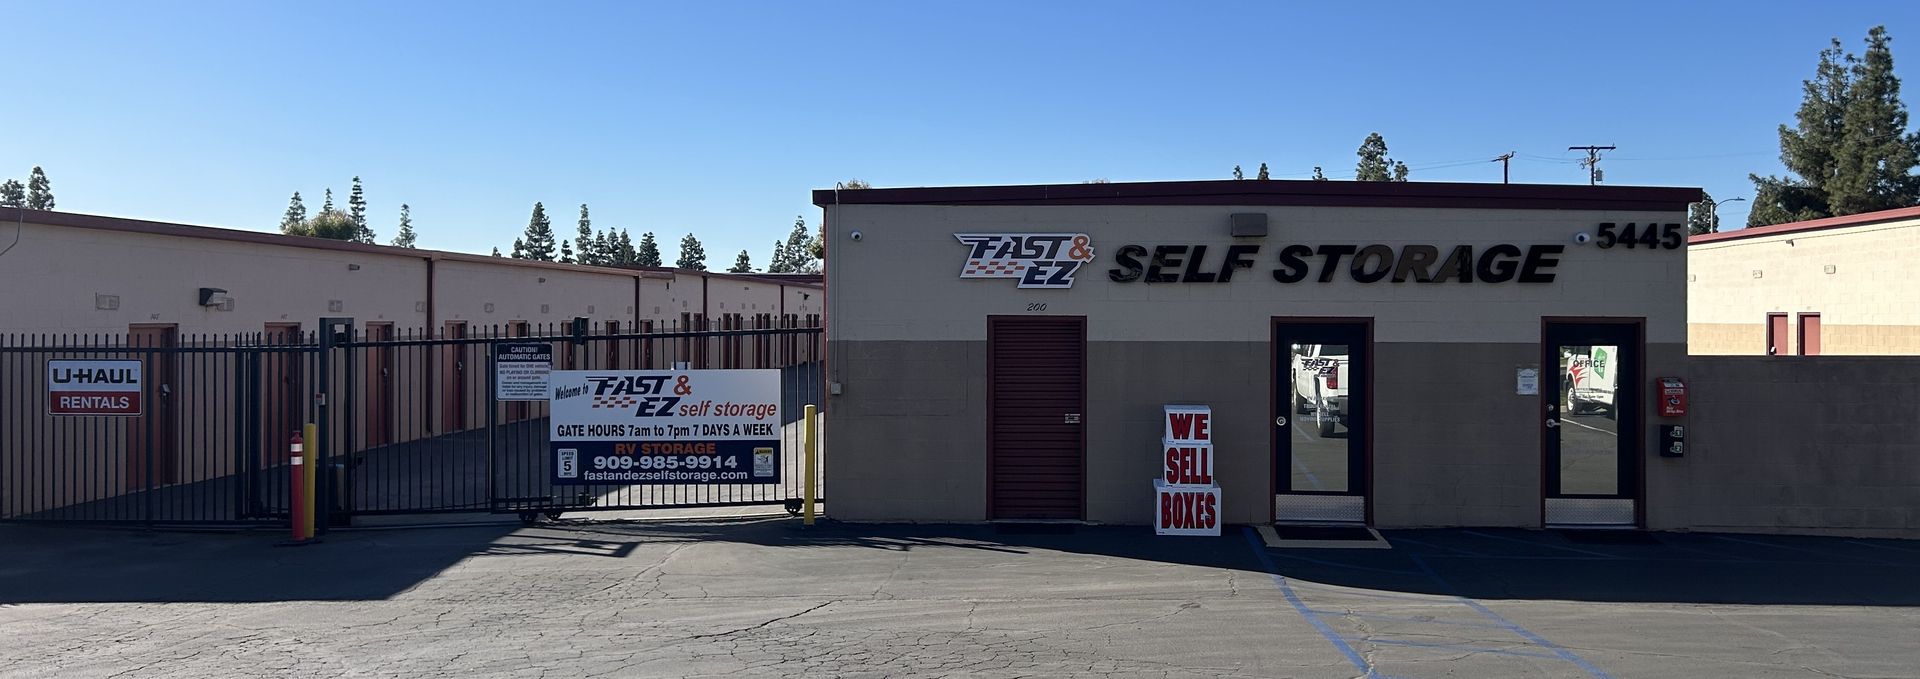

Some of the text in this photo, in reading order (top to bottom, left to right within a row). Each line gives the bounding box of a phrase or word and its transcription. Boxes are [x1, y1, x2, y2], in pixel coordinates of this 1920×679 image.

[1596, 221, 1681, 249] 5445
[960, 235, 1091, 260] FAST &
[1022, 260, 1079, 284] EZ
[1108, 244, 1564, 284] SELF STORAGE
[1027, 302, 1048, 312] 200
[1573, 360, 1605, 368] OFFICE
[53, 368, 137, 384] U-HAUL
[555, 384, 581, 400] Welcome
[583, 382, 589, 395] to
[586, 375, 692, 396] FAST &
[60, 396, 130, 409] RENTALS
[635, 396, 776, 421] EZ self storage
[557, 423, 773, 439] GATE HOURS 7am to 7pm 7 DAYS A WEEK
[1169, 413, 1209, 440] WE
[615, 443, 716, 455] RV STORAGE
[564, 461, 572, 471] 5
[593, 455, 738, 470] 909-985-9914
[1166, 447, 1212, 485] SELL
[584, 470, 748, 482] fastandezselfstorage.com
[1161, 492, 1216, 529] BOXES
